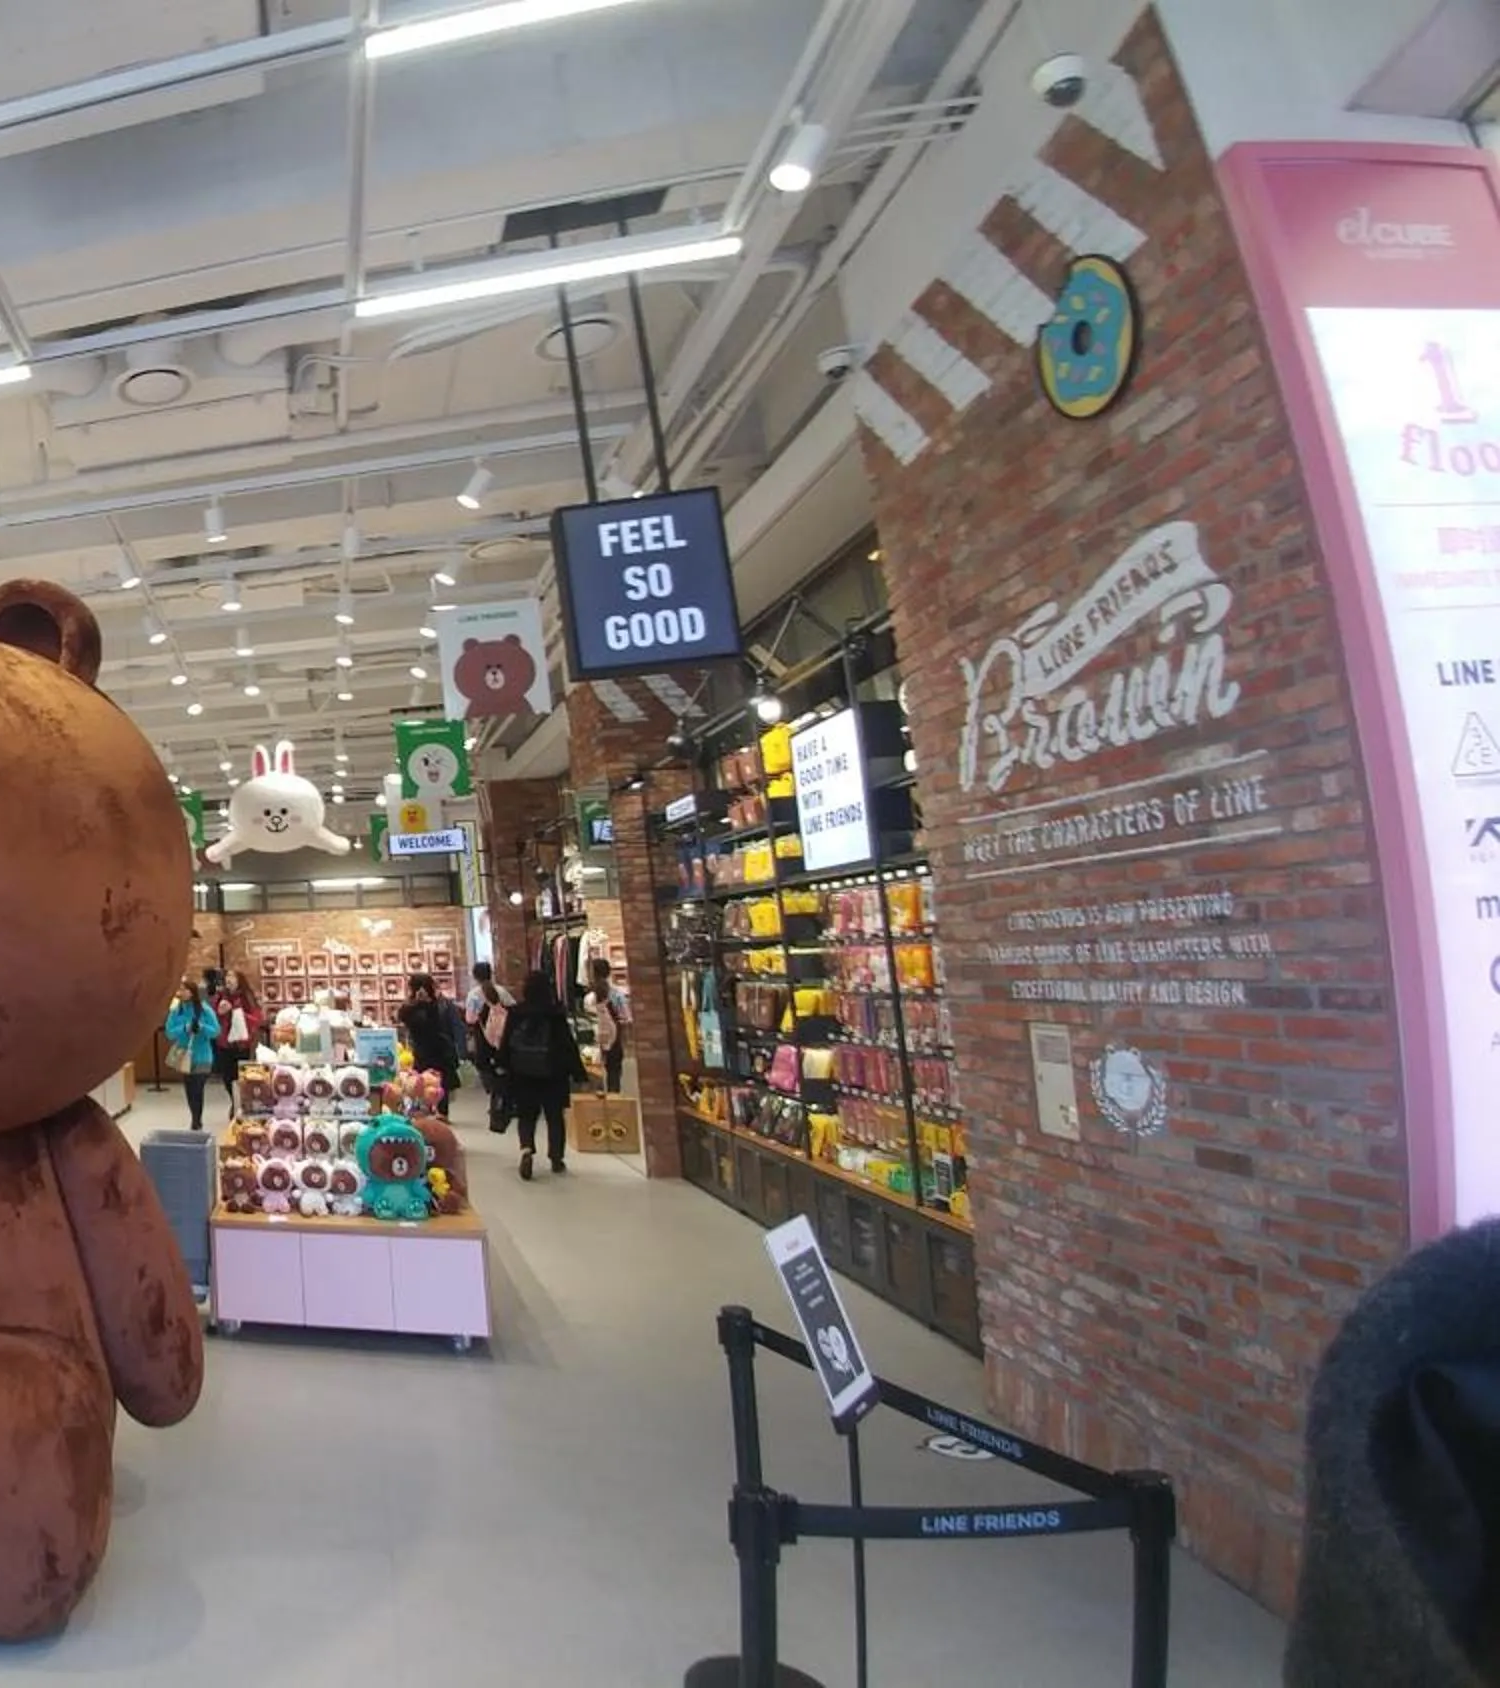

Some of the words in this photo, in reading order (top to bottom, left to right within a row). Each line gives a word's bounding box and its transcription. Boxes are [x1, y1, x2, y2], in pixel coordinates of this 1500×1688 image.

[598, 514, 688, 557] FEEL
[623, 563, 673, 600] SO
[604, 607, 706, 650] GOOD
[1038, 623, 1086, 678] LINE
[1436, 659, 1496, 686] LINE
[1041, 798, 1165, 851] CHARACTERS
[1174, 790, 1200, 826] OF
[1210, 776, 1269, 819] LINE
[1228, 931, 1276, 960] WITH
[1185, 980, 1247, 1005] DESIGN
[926, 1406, 959, 1430] LINE
[959, 1420, 1023, 1459] FRIENDS
[921, 1515, 969, 1533] LINE
[973, 1509, 1061, 1532] FRIENDS
